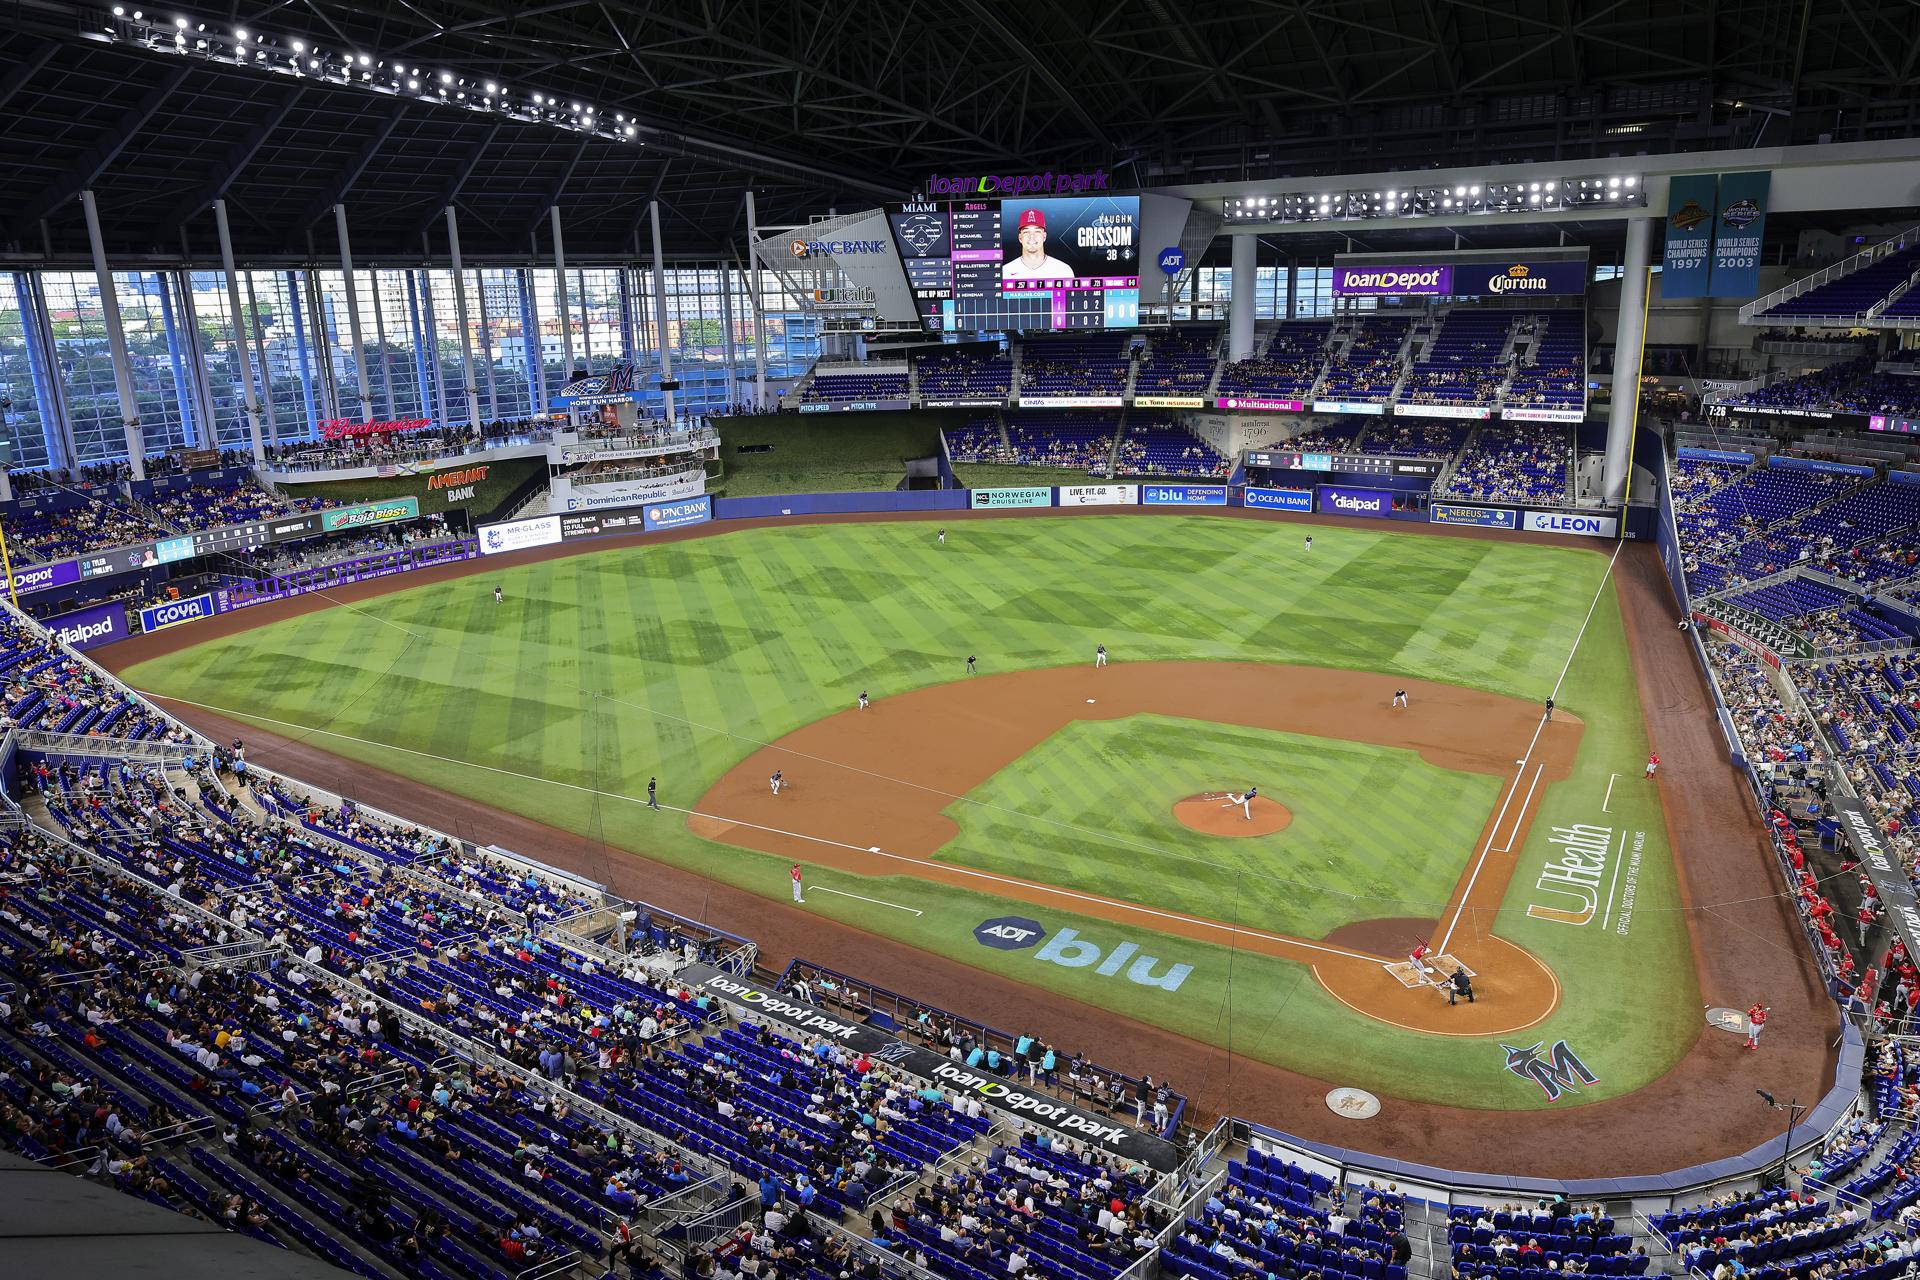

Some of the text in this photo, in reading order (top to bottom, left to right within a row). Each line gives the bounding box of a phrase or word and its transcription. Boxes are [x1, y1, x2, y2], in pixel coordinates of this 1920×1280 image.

[930, 170, 1110, 196] loanDepot park
[903, 203, 937, 213] MIAMI
[965, 203, 987, 211] ANGELS
[1099, 214, 1132, 224] VAUGHN
[1078, 226, 1132, 247] GRISSOM
[809, 240, 884, 254] PNC BANK
[1668, 239, 1708, 249] WORLD SERIES
[1717, 238, 1760, 247] WORLD SERIES
[1106, 249, 1118, 261] 3B
[1124, 249, 1130, 259] 5
[1667, 248, 1707, 258] CHAMPIONS
[1716, 247, 1759, 257] CHAMPIONS
[1161, 255, 1182, 266] ADT
[1671, 258, 1701, 269] 1997
[1718, 258, 1754, 268] 2003
[1343, 270, 1440, 290] loanDepot
[1488, 274, 1547, 294] Corona
[917, 290, 951, 298] DUE UP NEXT
[815, 403, 829, 411] SPEED
[1237, 400, 1292, 410] Multinational
[1709, 405, 1726, 417] 7:26
[317, 416, 433, 440] Budweiser
[427, 466, 488, 490] AMERANT
[447, 486, 475, 502] BANK
[991, 491, 1047, 499] NORWEGIAN
[1070, 488, 1085, 496] LIVE.
[1159, 489, 1183, 501] blu
[1258, 495, 1309, 506] OCEAN BANK
[1335, 495, 1380, 511] dialpad
[348, 511, 375, 524] Baja
[375, 506, 408, 519] Blast
[662, 501, 707, 518] PNC BANK
[1449, 508, 1481, 517] NEREUS
[306, 521, 312, 529] 4
[563, 517, 581, 525] SWING
[1550, 517, 1601, 532] LEON
[83, 558, 107, 569] 30 TYLER
[93, 565, 113, 576] PHILLIPS
[156, 603, 200, 624] GOYA
[56, 615, 113, 644] dialpad
[1527, 824, 1612, 925] UHealth
[1616, 831, 1646, 935] OFFICIAL DOCTORS OF THE MIAMI MARLINS
[981, 925, 1195, 992] ADT blu
[705, 975, 860, 1040] loanDepot park
[931, 1062, 1129, 1146] loanDepot park
